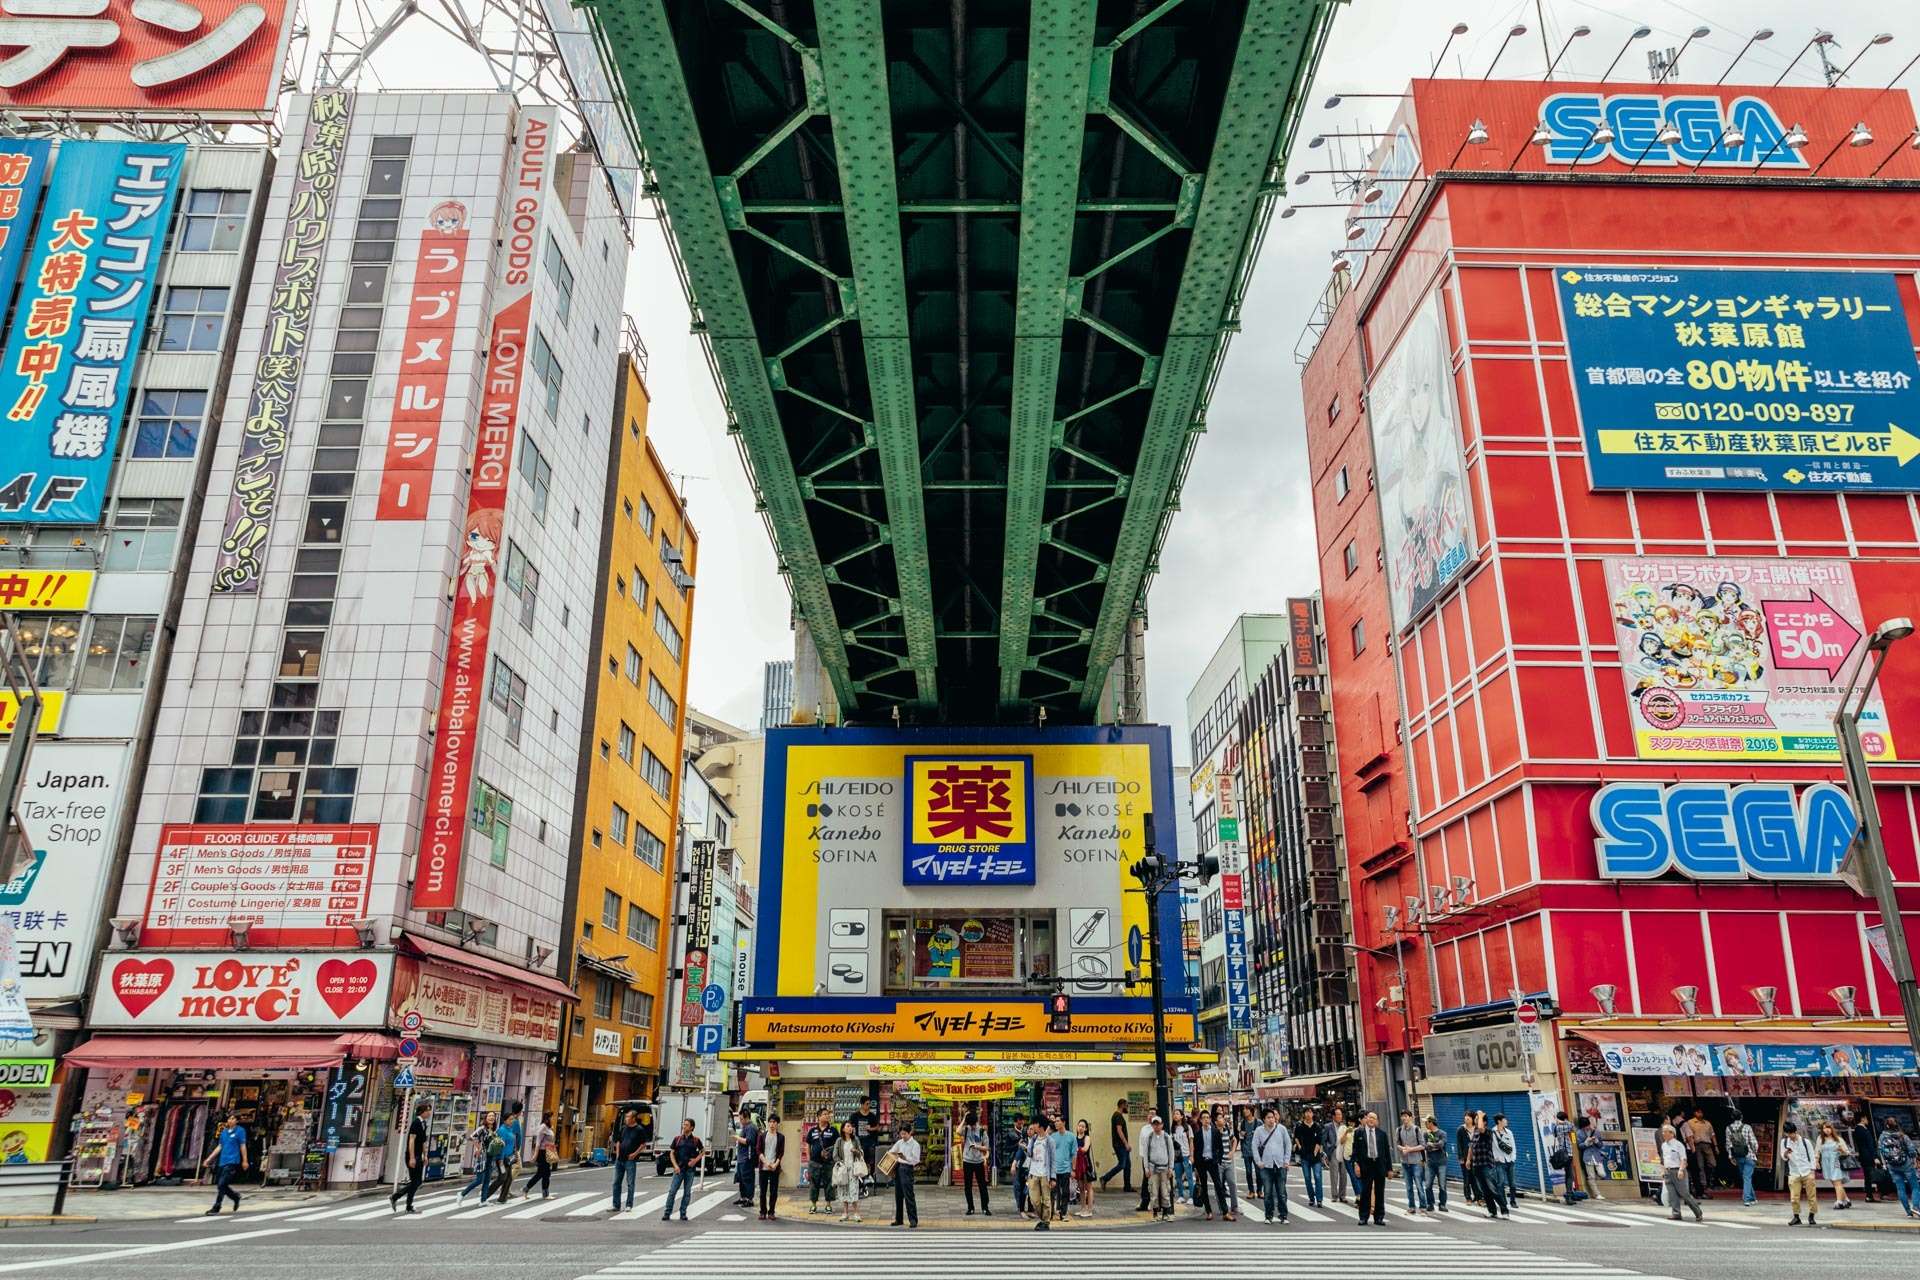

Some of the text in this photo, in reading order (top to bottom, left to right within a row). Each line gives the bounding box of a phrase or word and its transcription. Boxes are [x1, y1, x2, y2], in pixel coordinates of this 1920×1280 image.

[1538, 93, 1809, 168] SEGA
[506, 118, 548, 287] ADULT GOODS
[1584, 273, 1679, 285] 住友不動産のマンション
[6, 209, 97, 423] 大特売中!!
[50, 154, 173, 460] エアコン扇風機
[1573, 292, 1892, 320] 総合マンションギャラリー
[1675, 322, 1807, 350] 秋葉原館
[394, 248, 458, 508] ラブメルシー
[478, 328, 521, 488] LOVE MERCI
[1683, 402, 1856, 424] 0120-009-897
[1633, 431, 1893, 454] 住友不動産秋葉原ビル8F
[0, 472, 88, 513] 4F
[1622, 563, 1844, 586] セガコラボカフェ開催中!!
[1774, 613, 1834, 628] ここから
[1778, 630, 1844, 661] 50m
[427, 617, 477, 893] www.akibalovemerci.com
[1745, 737, 1779, 752] 2016
[37, 770, 110, 793] Japan.
[798, 780, 894, 796] SHISEIDO
[1044, 779, 1141, 796] SHISEIDO
[23, 800, 106, 821] Tax-free
[837, 802, 885, 818] KOSÉ
[927, 764, 1014, 840] 薬
[1085, 802, 1134, 817] KOSÉ
[48, 824, 101, 847] Shop
[204, 833, 244, 844] FLOOR
[245, 833, 280, 844] GUIDE
[808, 825, 882, 841] Kanebo
[1058, 824, 1132, 841] Kanebo
[1590, 783, 1876, 879] SEGA
[169, 847, 188, 859] 4F
[197, 847, 229, 859] Men's
[230, 847, 265, 859] Goods
[274, 847, 312, 859] 男性用品
[812, 848, 878, 864] SOFINA
[938, 845, 1000, 854] DRUG STORE
[1063, 847, 1130, 864] SOFINA
[166, 864, 184, 875] 3F
[194, 864, 225, 875] Men's
[227, 864, 263, 875] Goods
[271, 864, 309, 875] 男性用品
[703, 843, 714, 906] VIDEO
[911, 854, 1028, 881] マツモトキヨシ
[163, 881, 181, 893] 2F
[190, 881, 238, 893] Couple's
[240, 881, 277, 892] Goods
[162, 898, 178, 910] 1F
[187, 898, 238, 910] Costume
[240, 897, 286, 911] Lingerie
[184, 914, 218, 926] Fetish
[699, 909, 710, 948] DVD
[119, 973, 164, 988] 秋葉原
[191, 957, 298, 991] LOVE
[329, 976, 368, 985] OPEN 10:00
[738, 952, 747, 991] mouse
[325, 985, 367, 994] CLOSE 22:00
[705, 990, 716, 1009] P
[407, 1016, 418, 1026] 20
[767, 1021, 895, 1034] Matsumoto KiYoshi
[914, 1011, 1026, 1036] マツモトキヨシ
[703, 1027, 718, 1052] P
[945, 1081, 1013, 1095] Tax Free Shop
